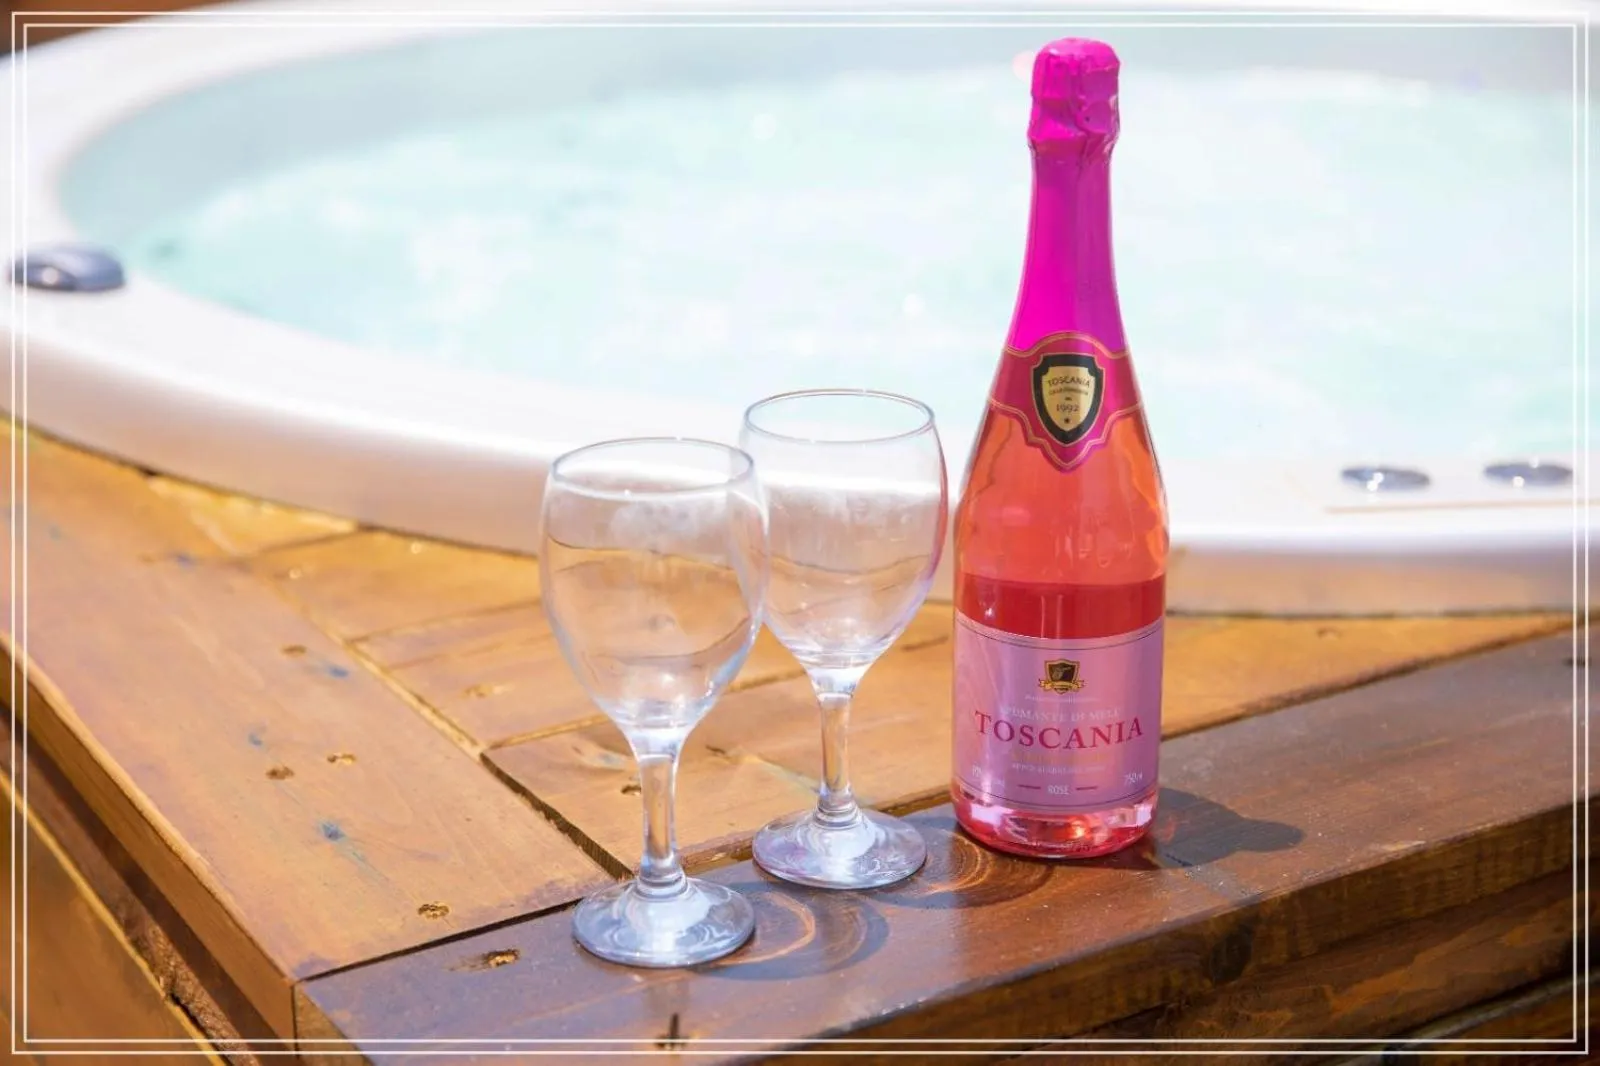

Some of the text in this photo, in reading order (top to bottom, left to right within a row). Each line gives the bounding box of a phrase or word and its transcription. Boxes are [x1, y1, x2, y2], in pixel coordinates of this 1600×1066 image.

[1047, 376, 1090, 388] TOSCANIA
[1056, 404, 1079, 413] 1992
[975, 710, 1144, 750] TOSCANIA
